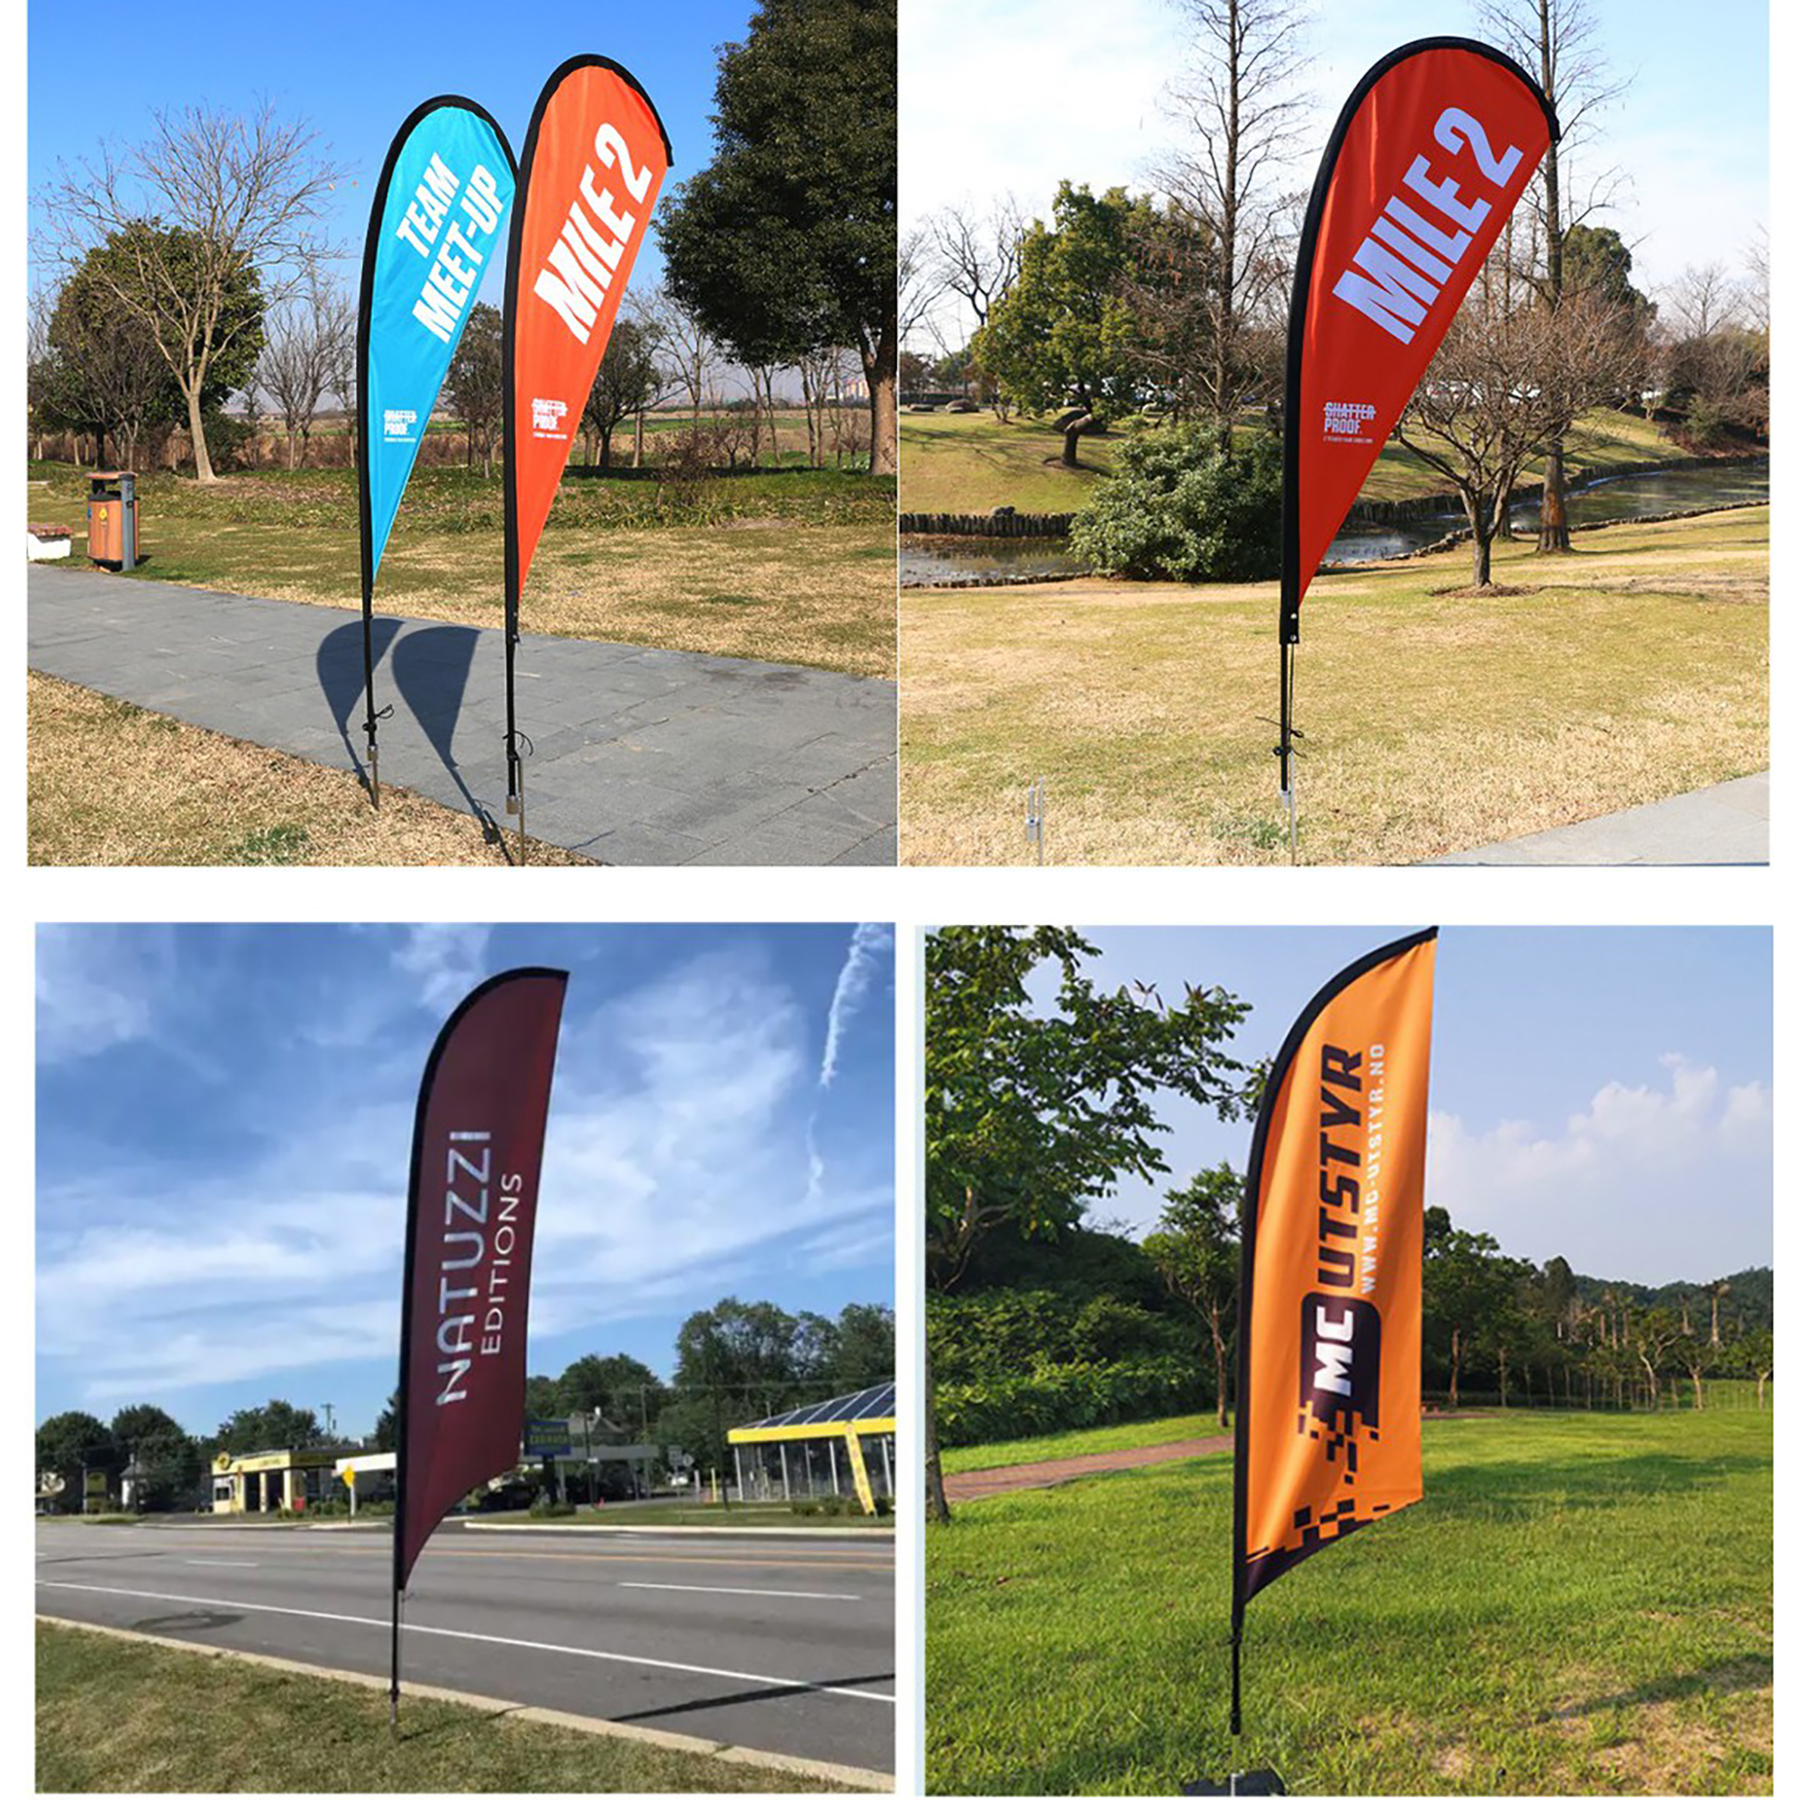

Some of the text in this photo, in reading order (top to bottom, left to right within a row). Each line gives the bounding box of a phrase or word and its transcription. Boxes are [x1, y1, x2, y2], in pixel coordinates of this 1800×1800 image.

[395, 152, 460, 259] TEAM
[412, 164, 504, 344] MEET-UP
[533, 163, 636, 345] MILE
[595, 122, 653, 205] 2
[1332, 153, 1493, 345] MILE
[1433, 106, 1524, 189] 2
[435, 1131, 491, 1407] NATUZZI
[480, 1173, 523, 1355] EDITIONS
[1313, 1043, 1363, 1397] MC UTSTYR
